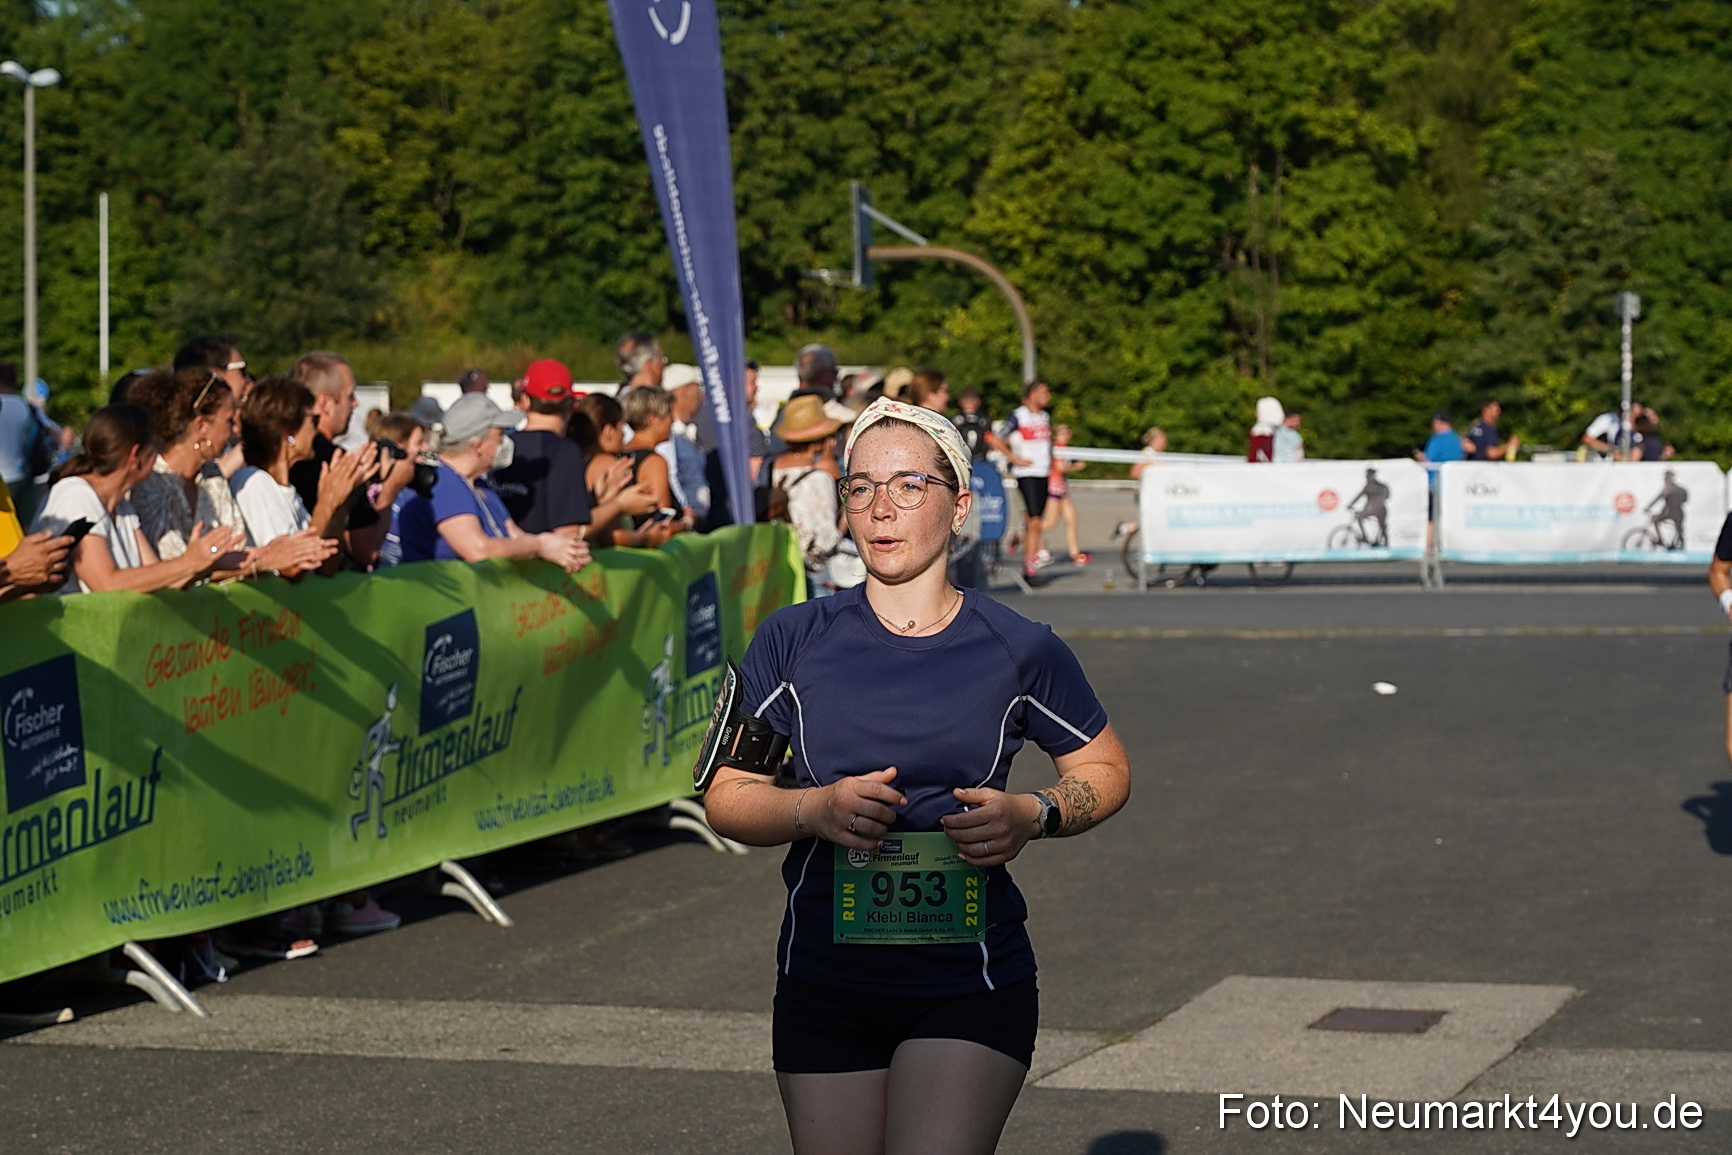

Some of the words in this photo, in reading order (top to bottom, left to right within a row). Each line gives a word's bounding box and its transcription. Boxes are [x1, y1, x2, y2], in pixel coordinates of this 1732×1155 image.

[145, 615, 234, 689] Gesunde
[238, 607, 302, 656] Firmen
[432, 648, 474, 677] Fischer
[15, 703, 65, 738] Fischer
[182, 674, 243, 735] laufen
[395, 684, 524, 801] firmenlauf
[872, 852, 920, 863] Firmenlauf
[890, 859, 919, 867] neumarkt
[842, 883, 856, 921] RUN
[871, 871, 948, 908] 953
[965, 876, 979, 927] 2022
[866, 911, 902, 923] Klebl
[906, 911, 954, 923] Bianca
